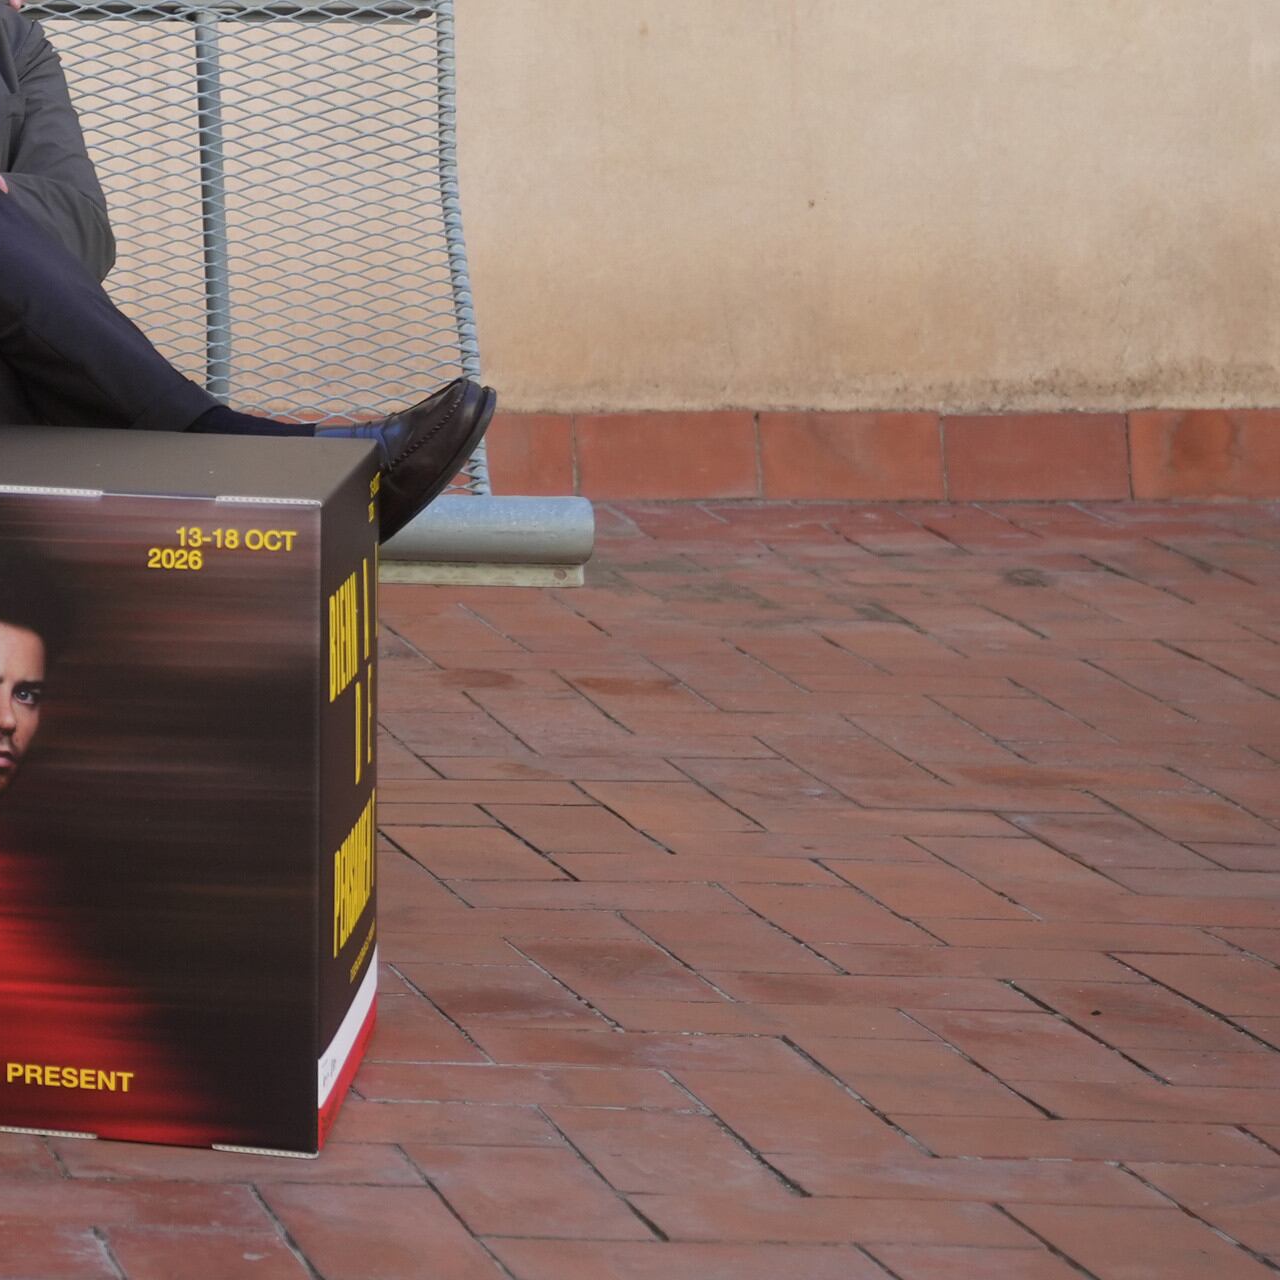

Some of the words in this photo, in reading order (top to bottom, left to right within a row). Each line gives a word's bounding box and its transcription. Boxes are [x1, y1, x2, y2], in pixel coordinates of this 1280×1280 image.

[177, 527, 239, 550] 13-18
[244, 529, 299, 553] OCT
[147, 547, 205, 572] 2026
[7, 1063, 135, 1093] PRESENT
